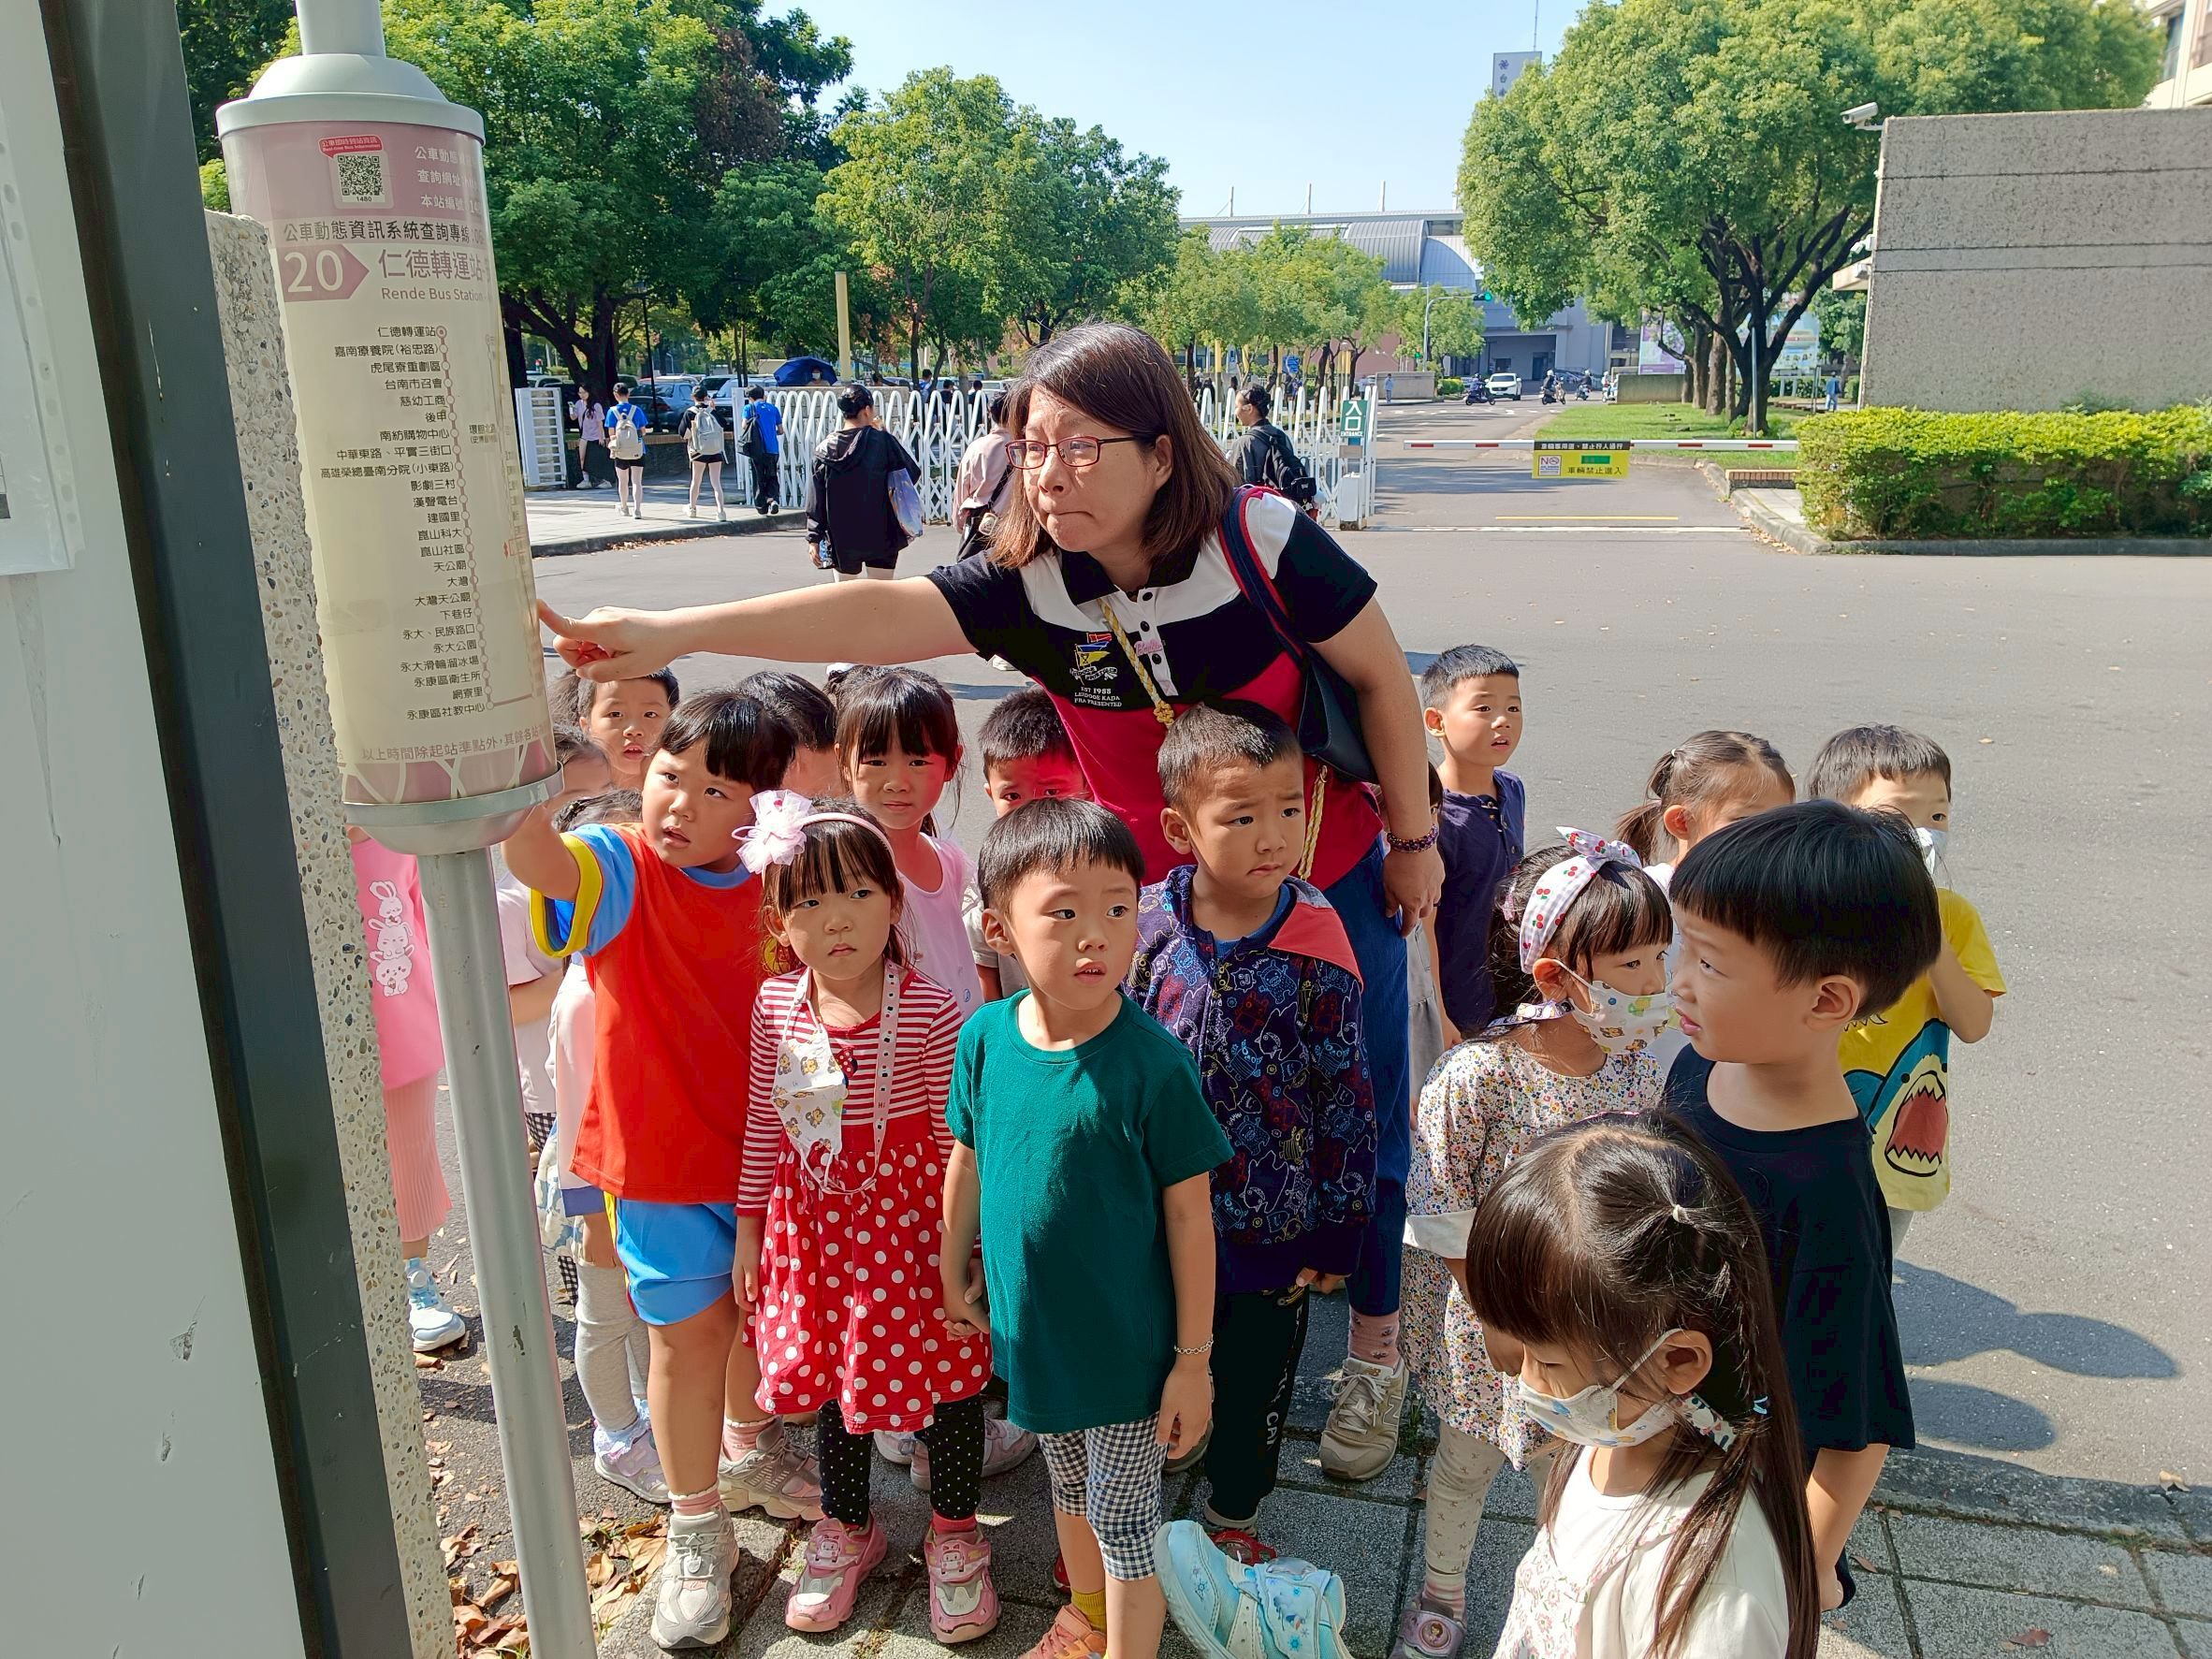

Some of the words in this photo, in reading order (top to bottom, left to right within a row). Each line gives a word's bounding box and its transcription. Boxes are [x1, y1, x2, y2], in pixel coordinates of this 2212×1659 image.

[284, 250, 343, 293] 20
[382, 287, 426, 300] Rende
[429, 288, 451, 300] Bus
[454, 288, 483, 301] Station
[377, 326, 436, 338] 仁德轉運站
[371, 360, 441, 373] 虎尾寮重劃區
[385, 378, 443, 390] 台南市召會
[400, 395, 445, 407] 慈幼工商
[425, 411, 447, 423] 後甲
[1346, 400, 1362, 431] 入口
[380, 429, 449, 442] 南紡購物中心
[411, 478, 456, 491] 影劇三村
[413, 496, 458, 508] 漢聲電台
[427, 511, 460, 524] 建國里
[418, 527, 462, 541] 崑山科大
[420, 544, 465, 557] 崑山社區
[433, 560, 467, 573] 天公廟
[447, 575, 469, 588] 大灣
[415, 591, 472, 606] 大灣天公廟
[440, 607, 473, 620] 下巷仔
[433, 639, 477, 654] 永大公園
[414, 670, 481, 688] 永康區衛生所
[453, 686, 484, 700] 網寮里
[406, 702, 486, 720] 永康區社教中心
